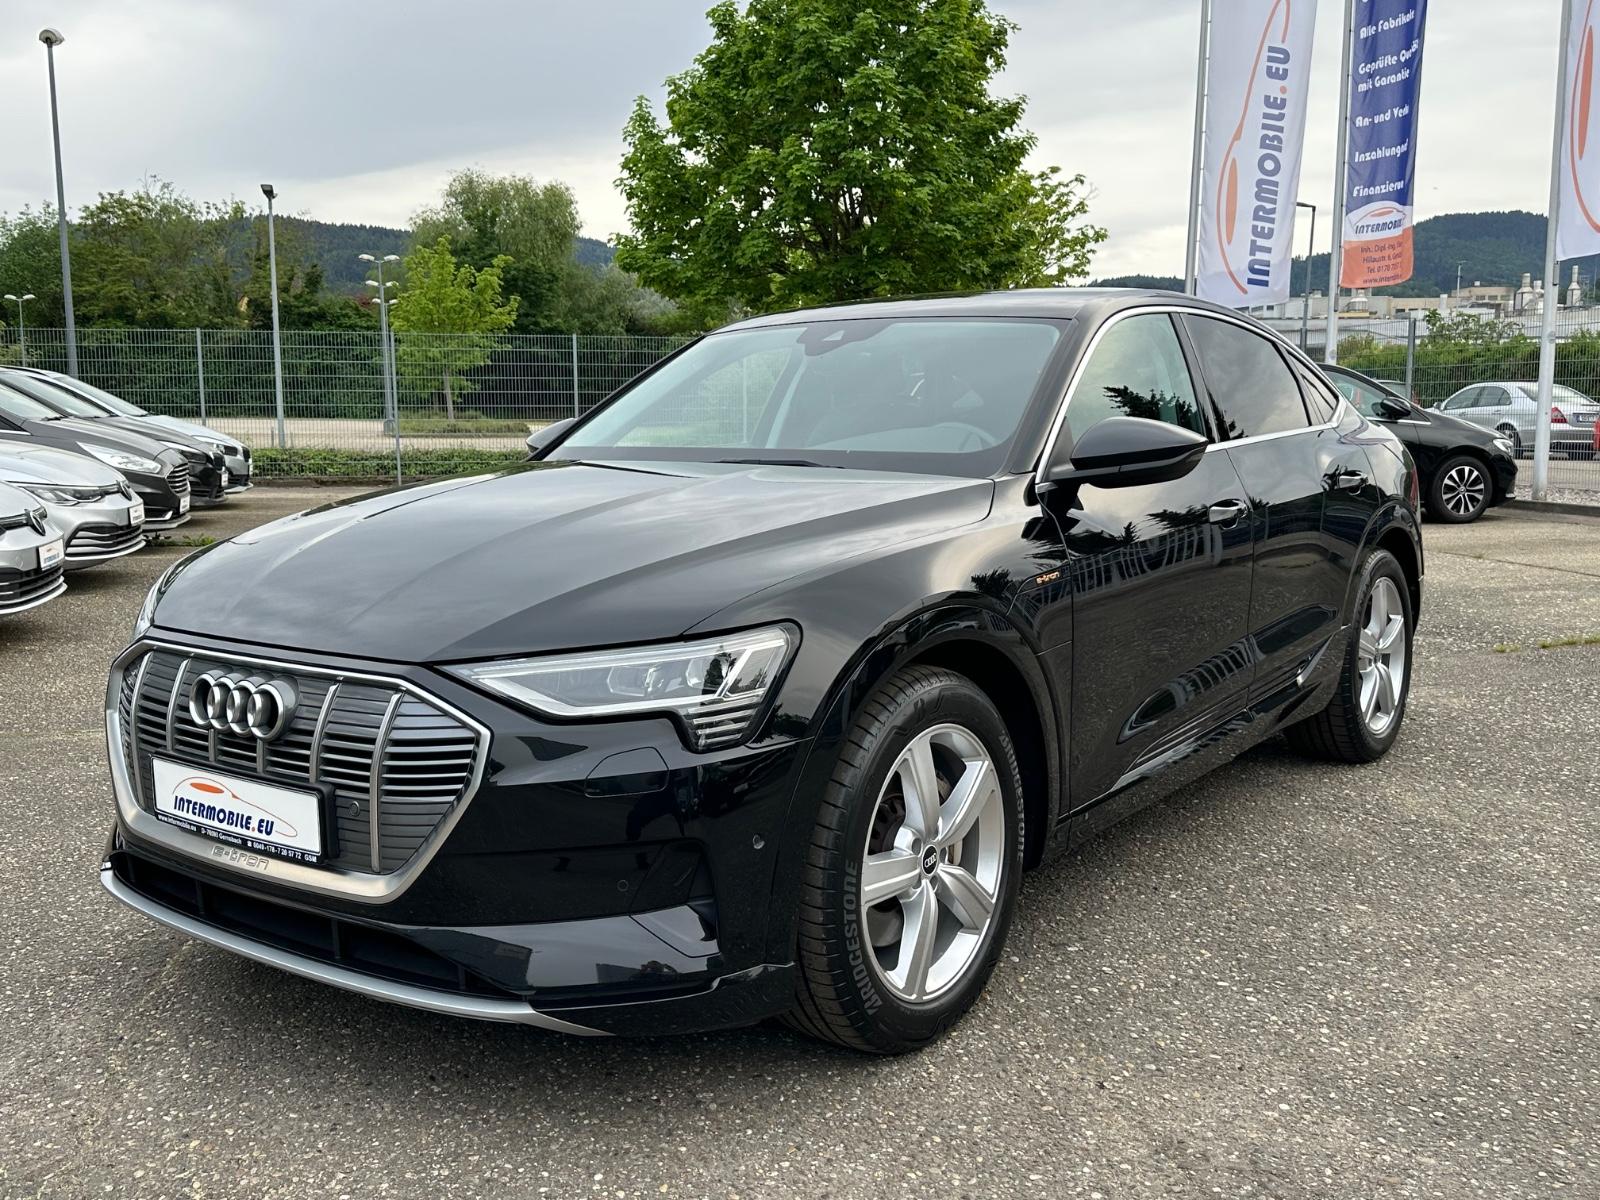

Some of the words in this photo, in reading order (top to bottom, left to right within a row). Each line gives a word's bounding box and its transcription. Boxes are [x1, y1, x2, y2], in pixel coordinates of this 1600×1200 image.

[1360, 25, 1377, 39] Alle
[1359, 54, 1398, 74] Geprüfte
[1358, 78, 1373, 93] mit
[1355, 116, 1372, 127] An-
[1374, 109, 1391, 124] und
[1247, 45, 1291, 288] INTERMOBILE.EU
[173, 795, 275, 837] INTERMOBILE.EU
[212, 845, 270, 871] e-tron
[843, 859, 883, 1016] BRIDGESTONE
